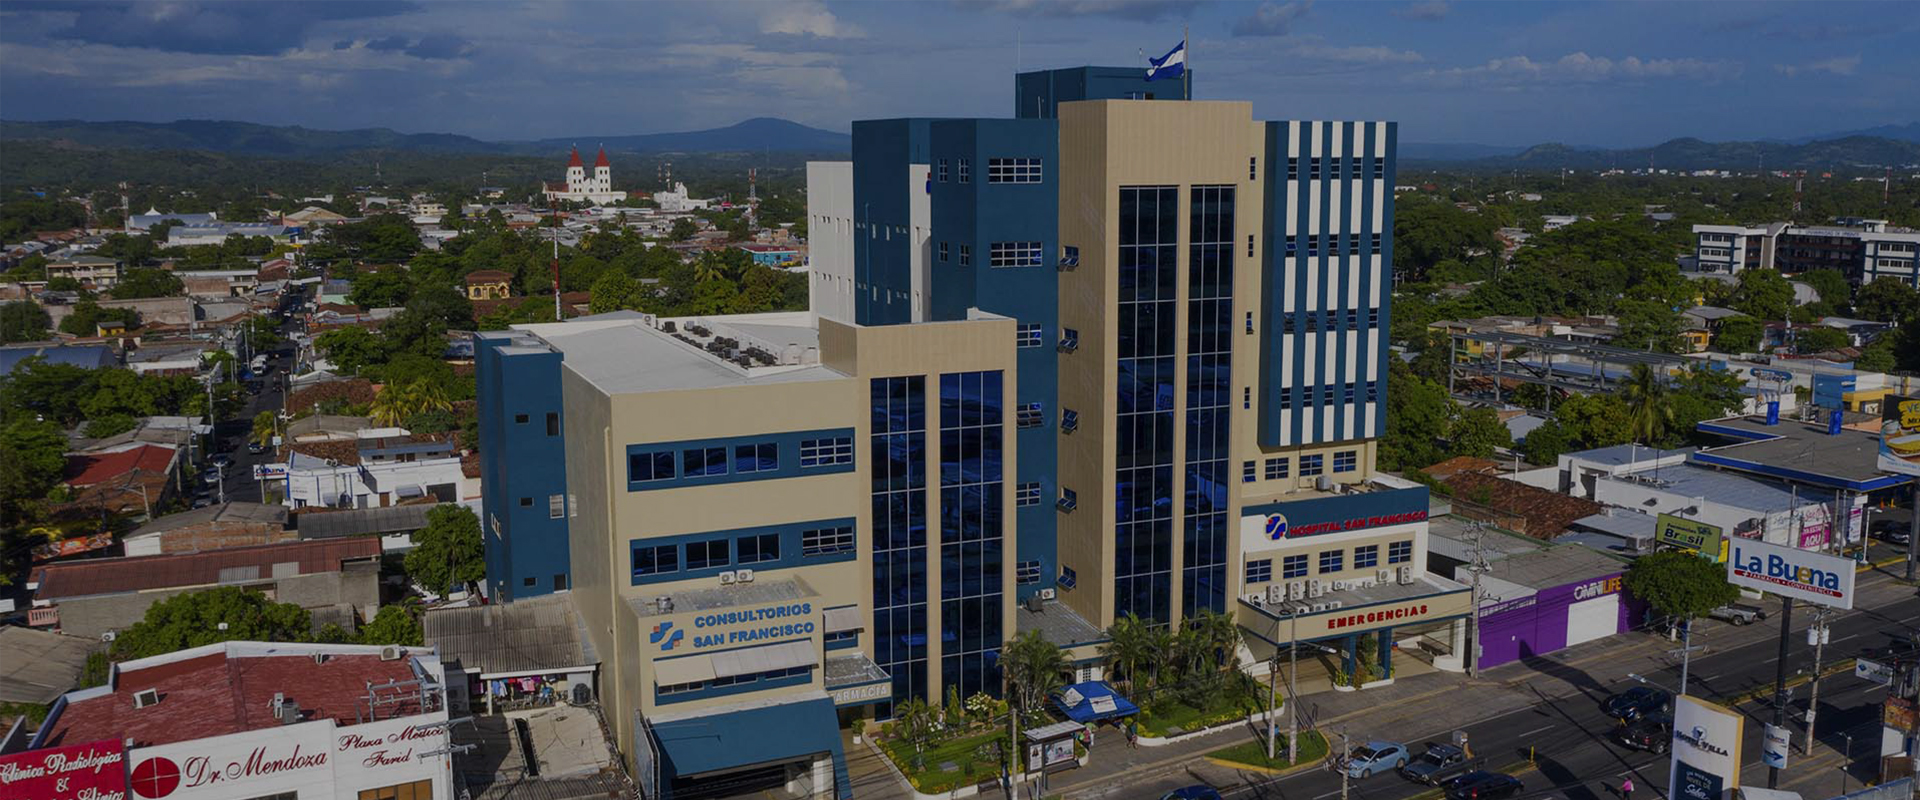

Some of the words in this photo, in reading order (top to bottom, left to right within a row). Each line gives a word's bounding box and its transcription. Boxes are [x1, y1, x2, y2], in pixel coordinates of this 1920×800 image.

[1290, 522, 1341, 536] HOSPITAL
[1344, 518, 1366, 530] SAN
[1369, 511, 1427, 526] FRANCISCO
[1664, 528, 1704, 546] Brasil
[1734, 547, 1762, 574] La
[1768, 554, 1839, 590] Buena
[1573, 576, 1622, 601] OMNILIFE
[1750, 573, 1780, 584] FARMACIA
[1787, 581, 1834, 596] CONVENIENCIA
[694, 603, 811, 628] CONSULTORIOS
[1328, 605, 1428, 629] EMERGENCIAS
[693, 633, 724, 648] SAN
[729, 622, 815, 643] FRANCISCO
[183, 756, 225, 787] Dr.
[226, 744, 328, 780] Mendoza
[362, 748, 411, 769] Farid
[56, 777, 70, 793] &
